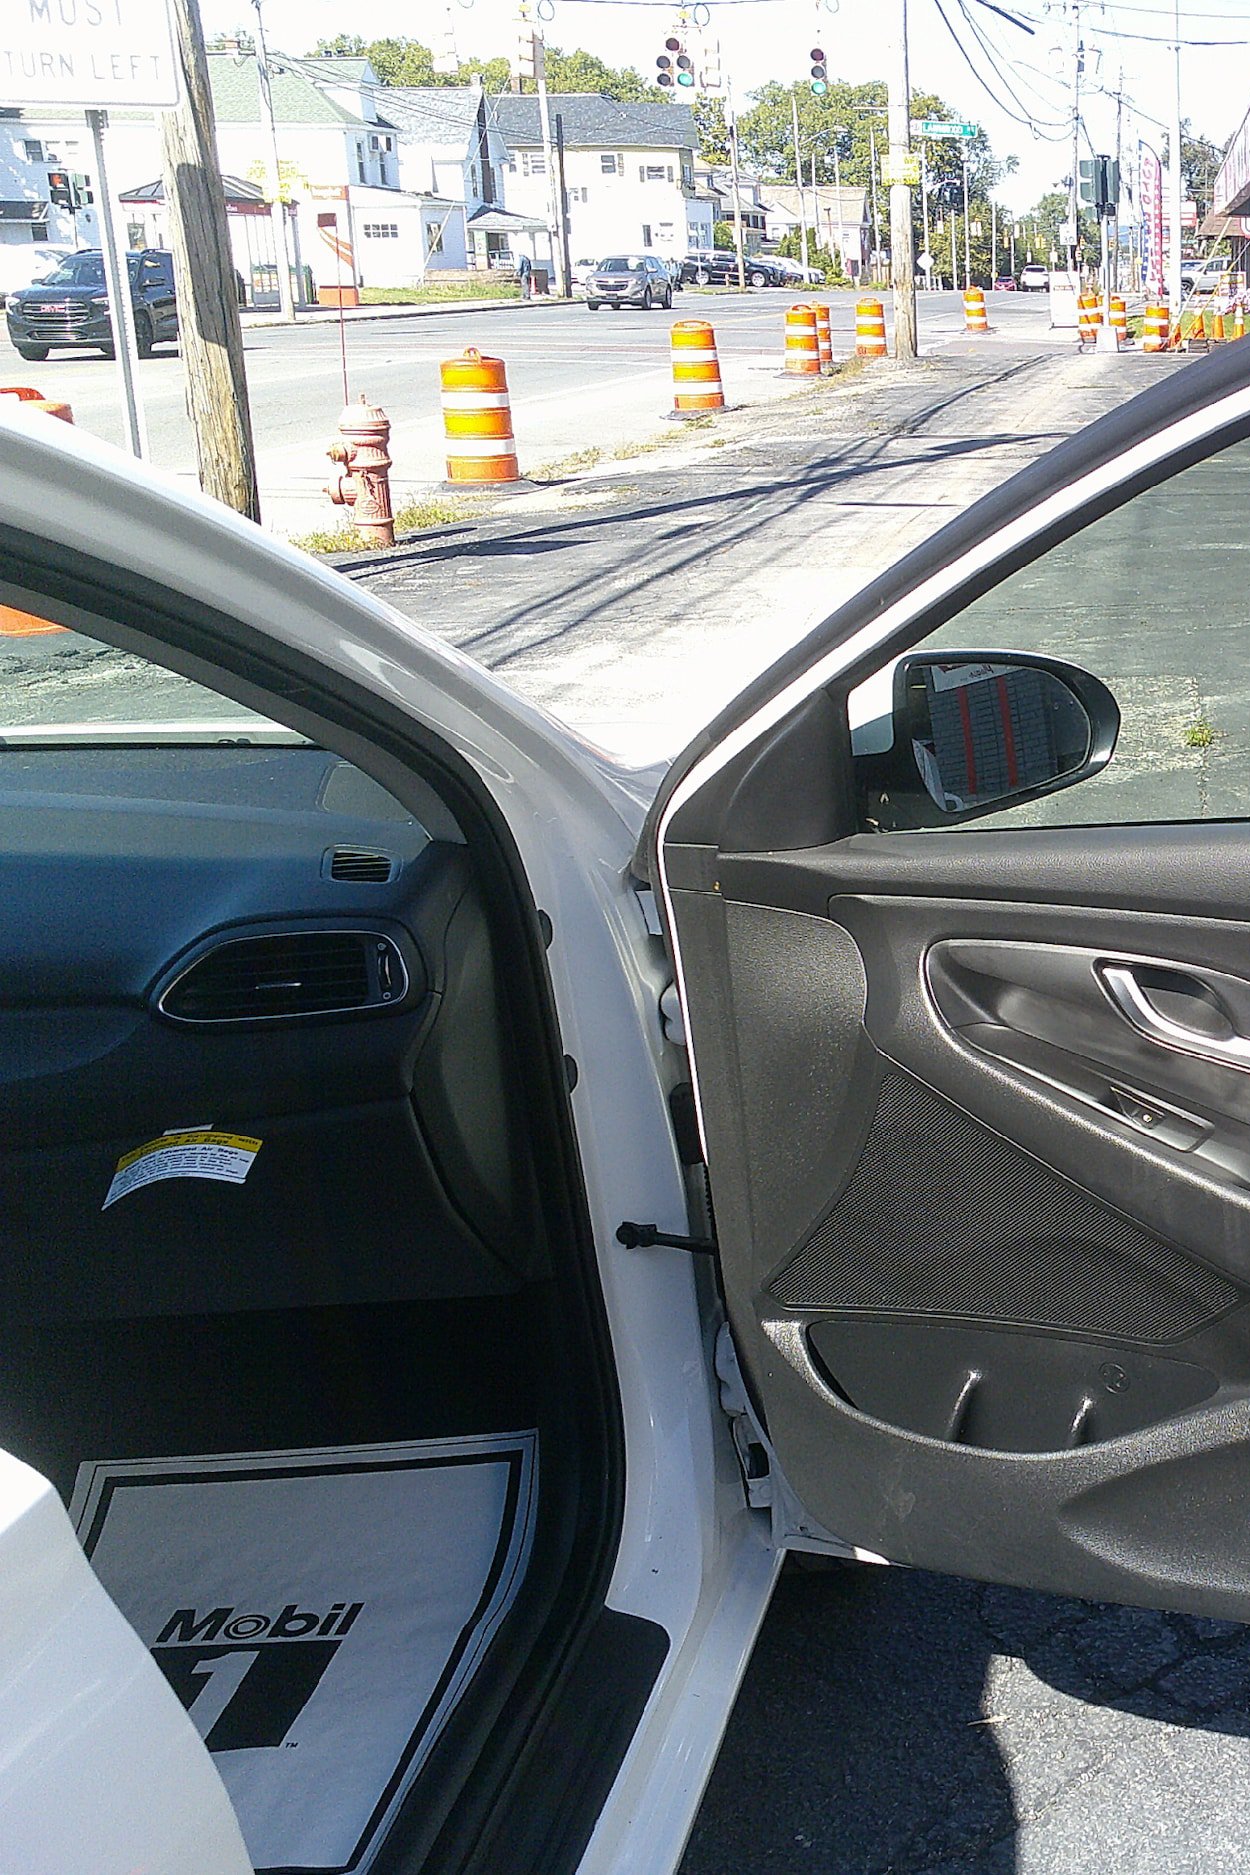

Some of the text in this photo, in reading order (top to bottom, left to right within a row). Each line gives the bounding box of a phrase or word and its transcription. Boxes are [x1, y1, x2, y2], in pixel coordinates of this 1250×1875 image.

[28, 0, 122, 26] MUST
[4, 51, 160, 80] TURN LEFT
[155, 1602, 365, 1643] Mobil
[188, 1650, 261, 1740] 1
